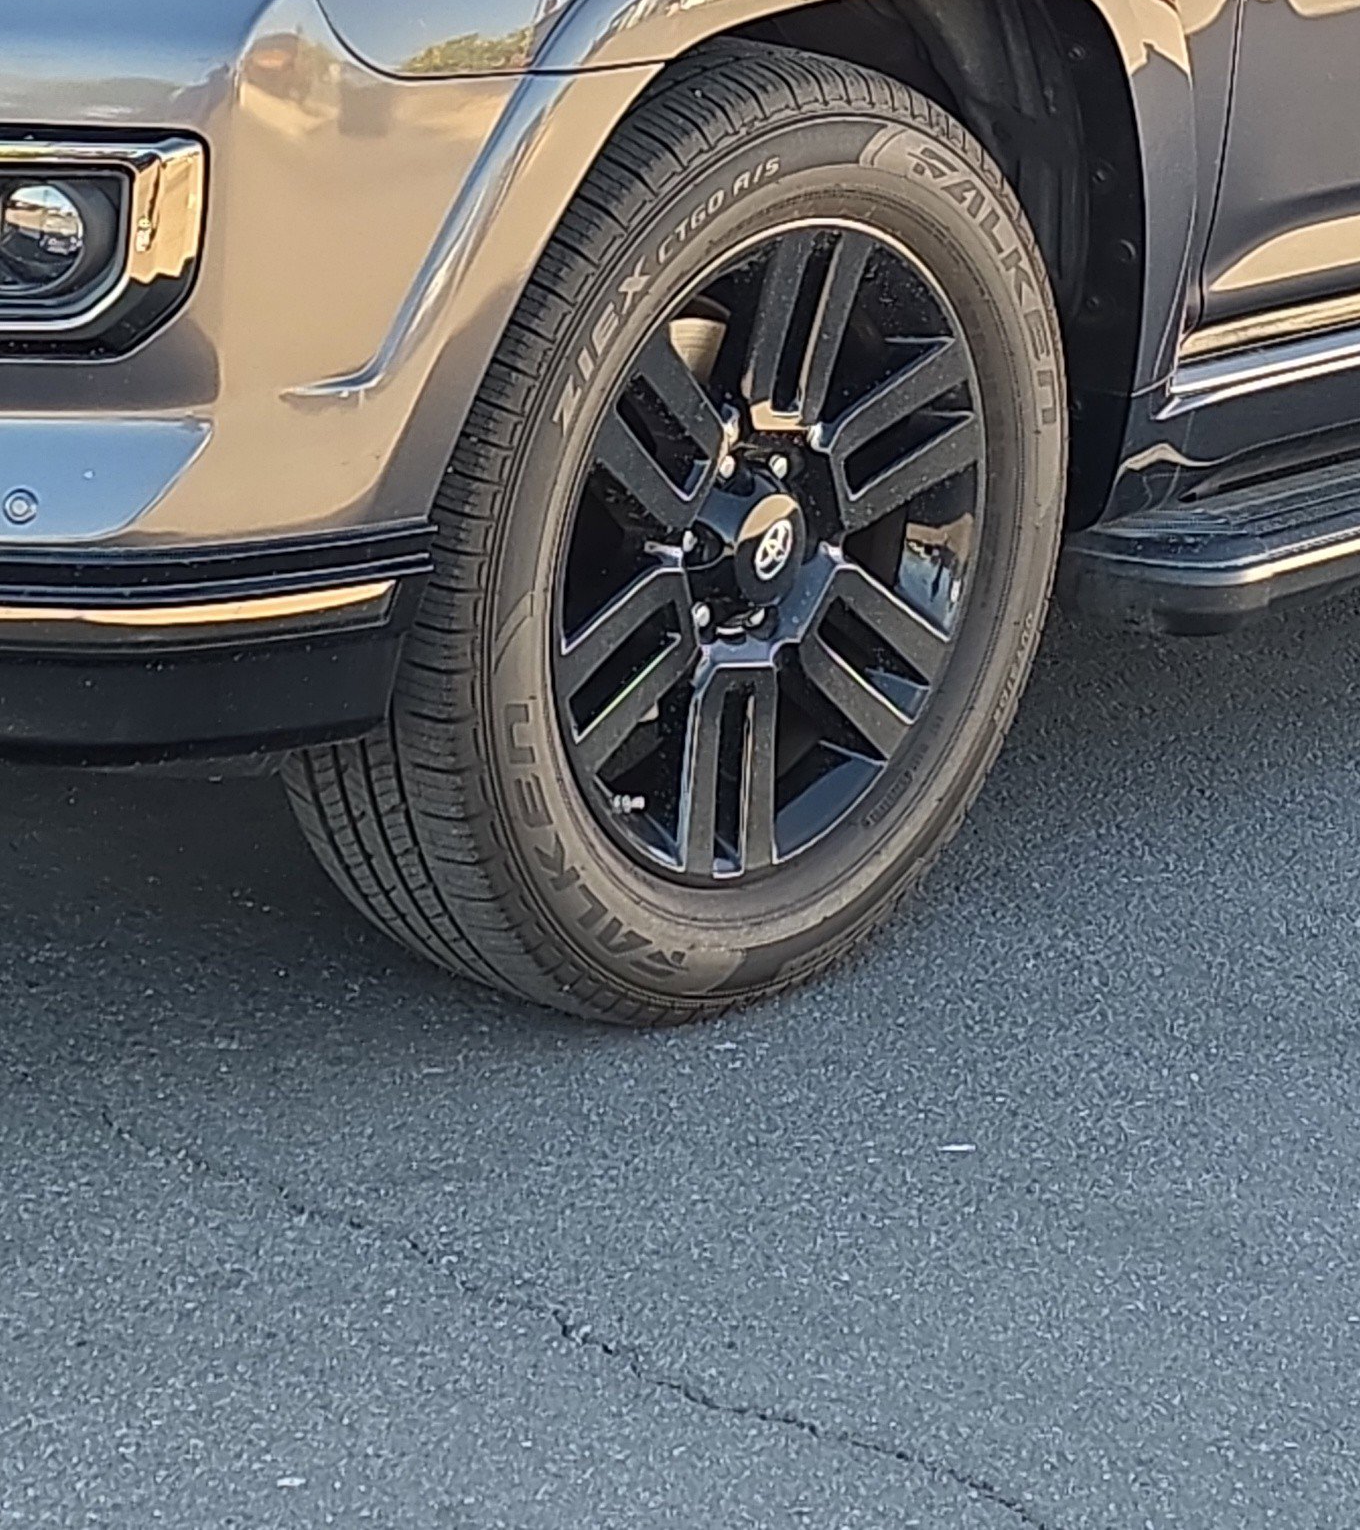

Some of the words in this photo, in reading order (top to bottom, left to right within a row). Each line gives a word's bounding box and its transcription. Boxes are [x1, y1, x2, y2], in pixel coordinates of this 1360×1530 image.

[552, 255, 651, 439] ZIEX
[656, 187, 727, 266] CT60
[731, 155, 782, 197] A/S
[906, 146, 1058, 426] FALKEN
